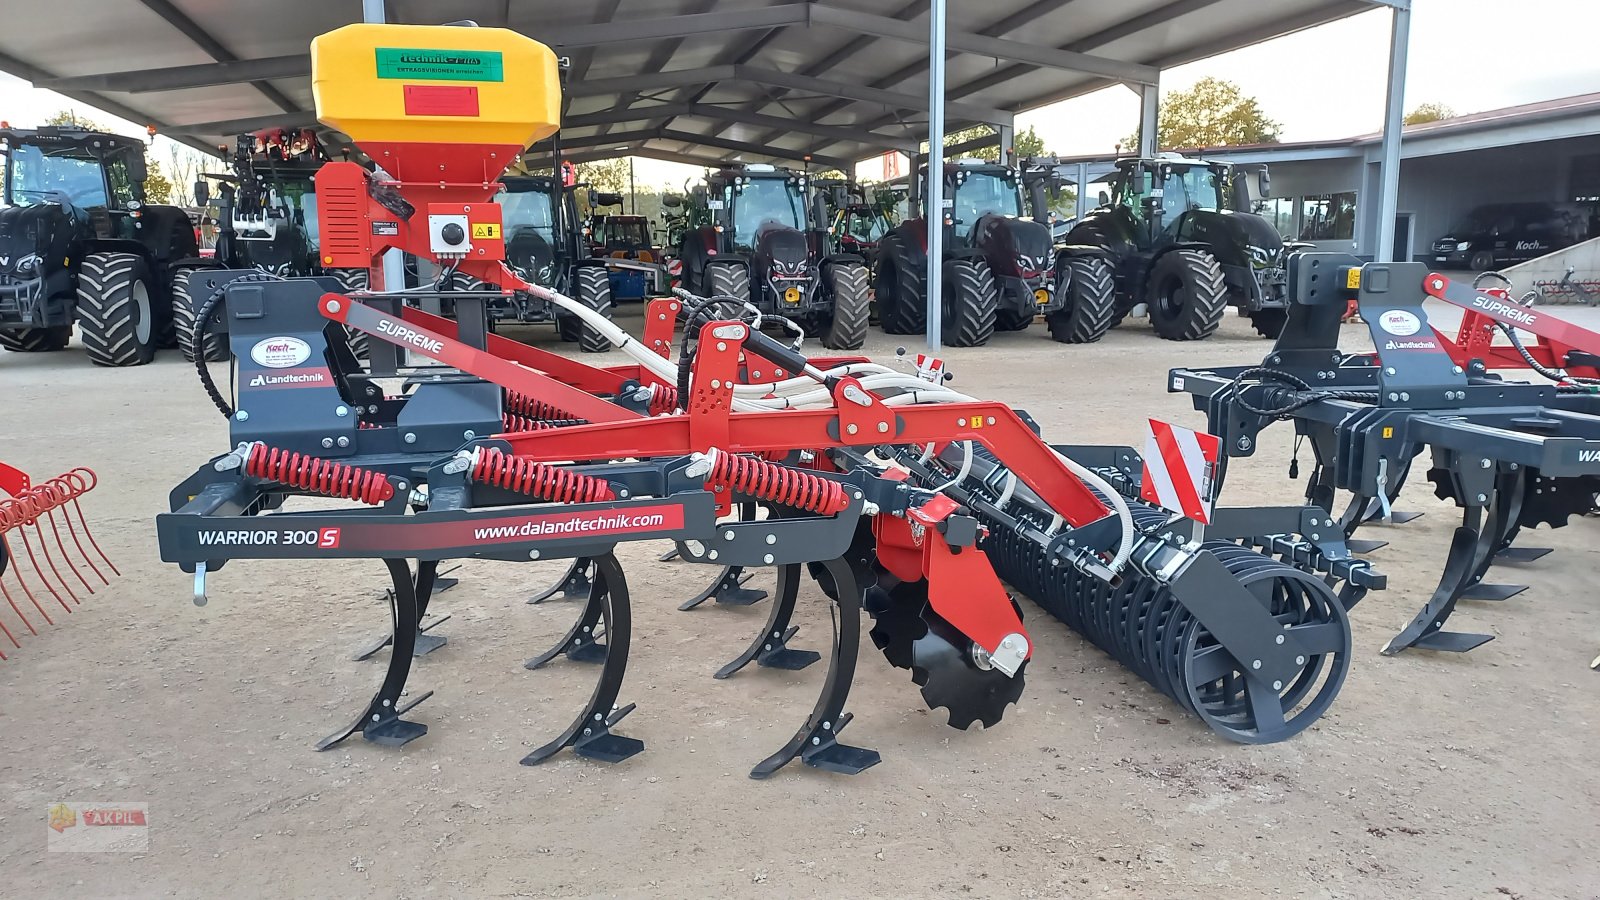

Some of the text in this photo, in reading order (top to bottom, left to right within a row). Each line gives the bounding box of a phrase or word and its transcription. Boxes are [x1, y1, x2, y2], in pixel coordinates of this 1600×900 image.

[1515, 240, 1540, 250] Koch
[1473, 296, 1537, 326] SUPREME
[376, 319, 445, 354] SUPREME
[266, 343, 289, 353] Koch
[265, 373, 324, 384] Landtechnik
[474, 514, 664, 540] www.dalandtechnik.com
[198, 530, 278, 545] WARRIOR
